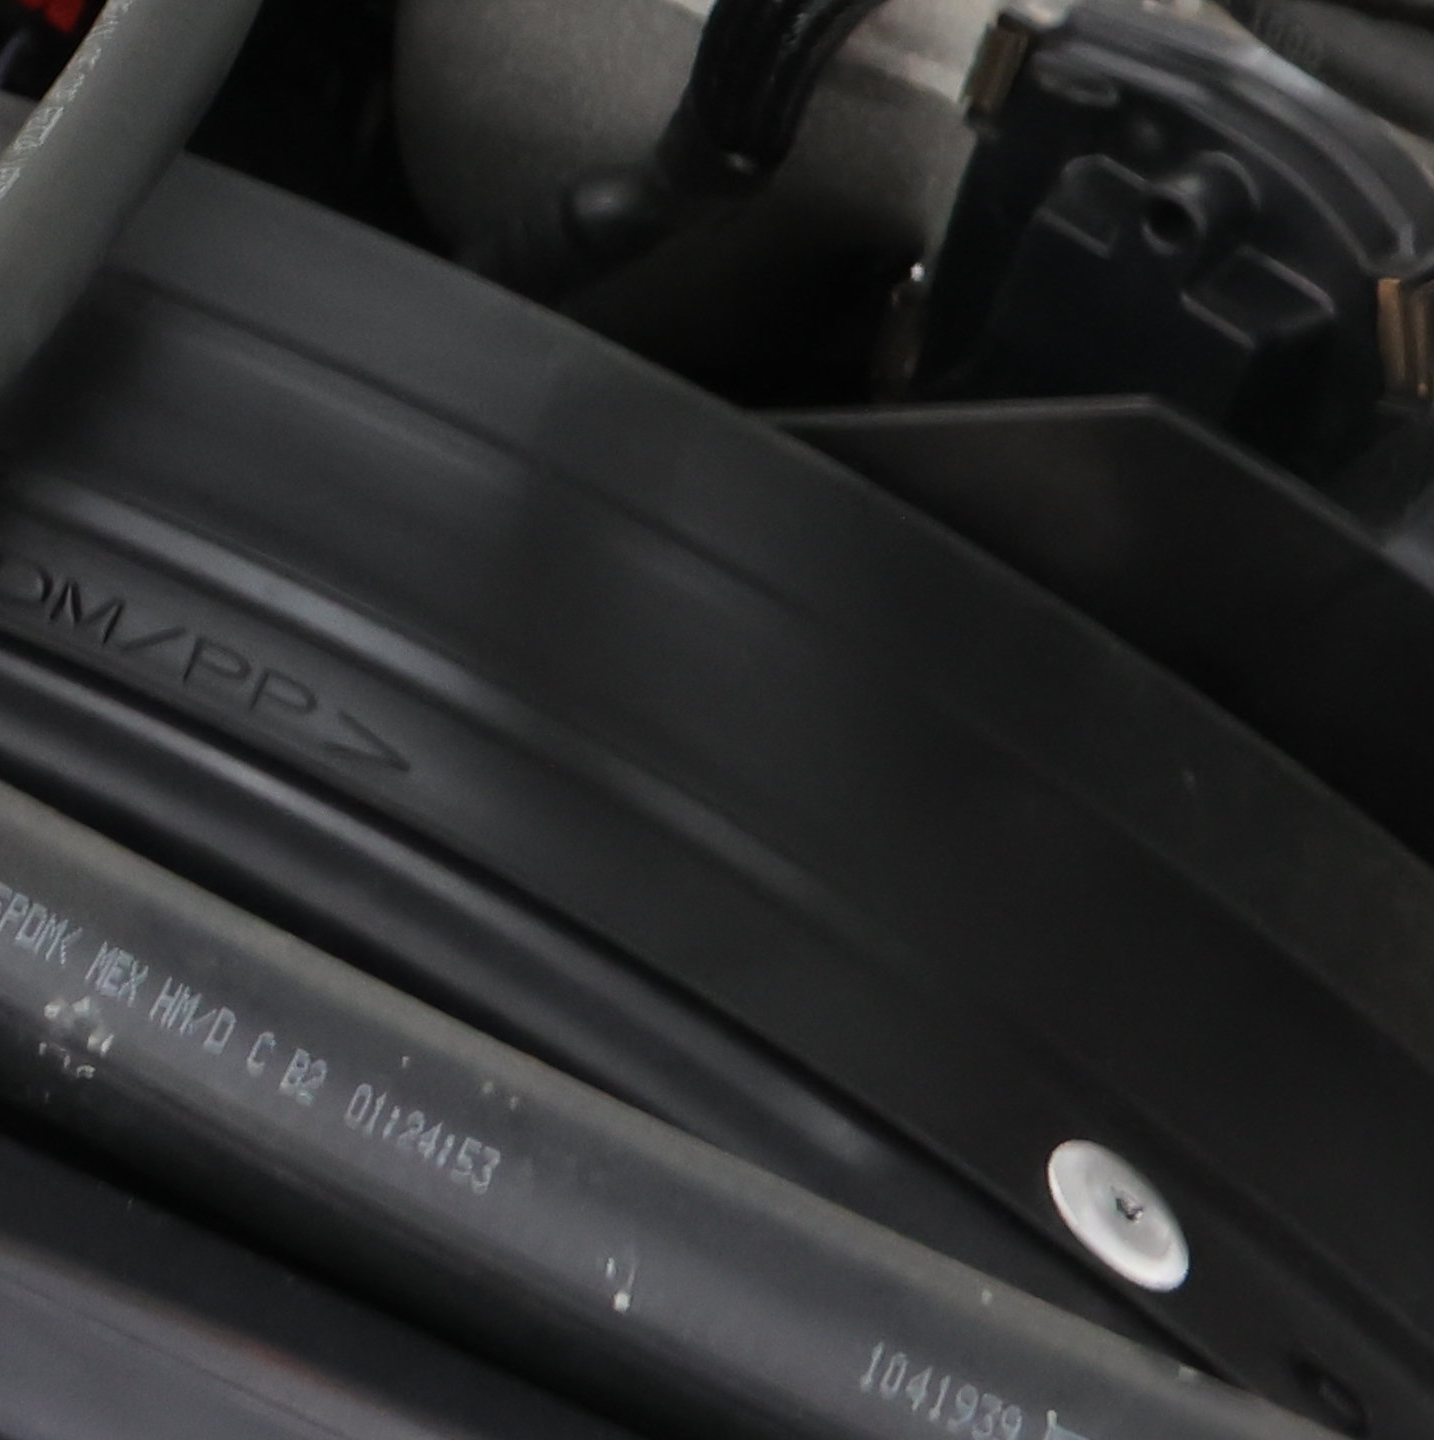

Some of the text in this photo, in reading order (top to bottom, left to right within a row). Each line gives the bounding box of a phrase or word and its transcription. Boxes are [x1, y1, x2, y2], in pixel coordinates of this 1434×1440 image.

[85, 942, 149, 1005] MEX
[149, 978, 236, 1053] HM/D
[245, 1030, 277, 1075] C
[278, 1048, 328, 1105] B2
[346, 1084, 501, 1192] 01:24:53
